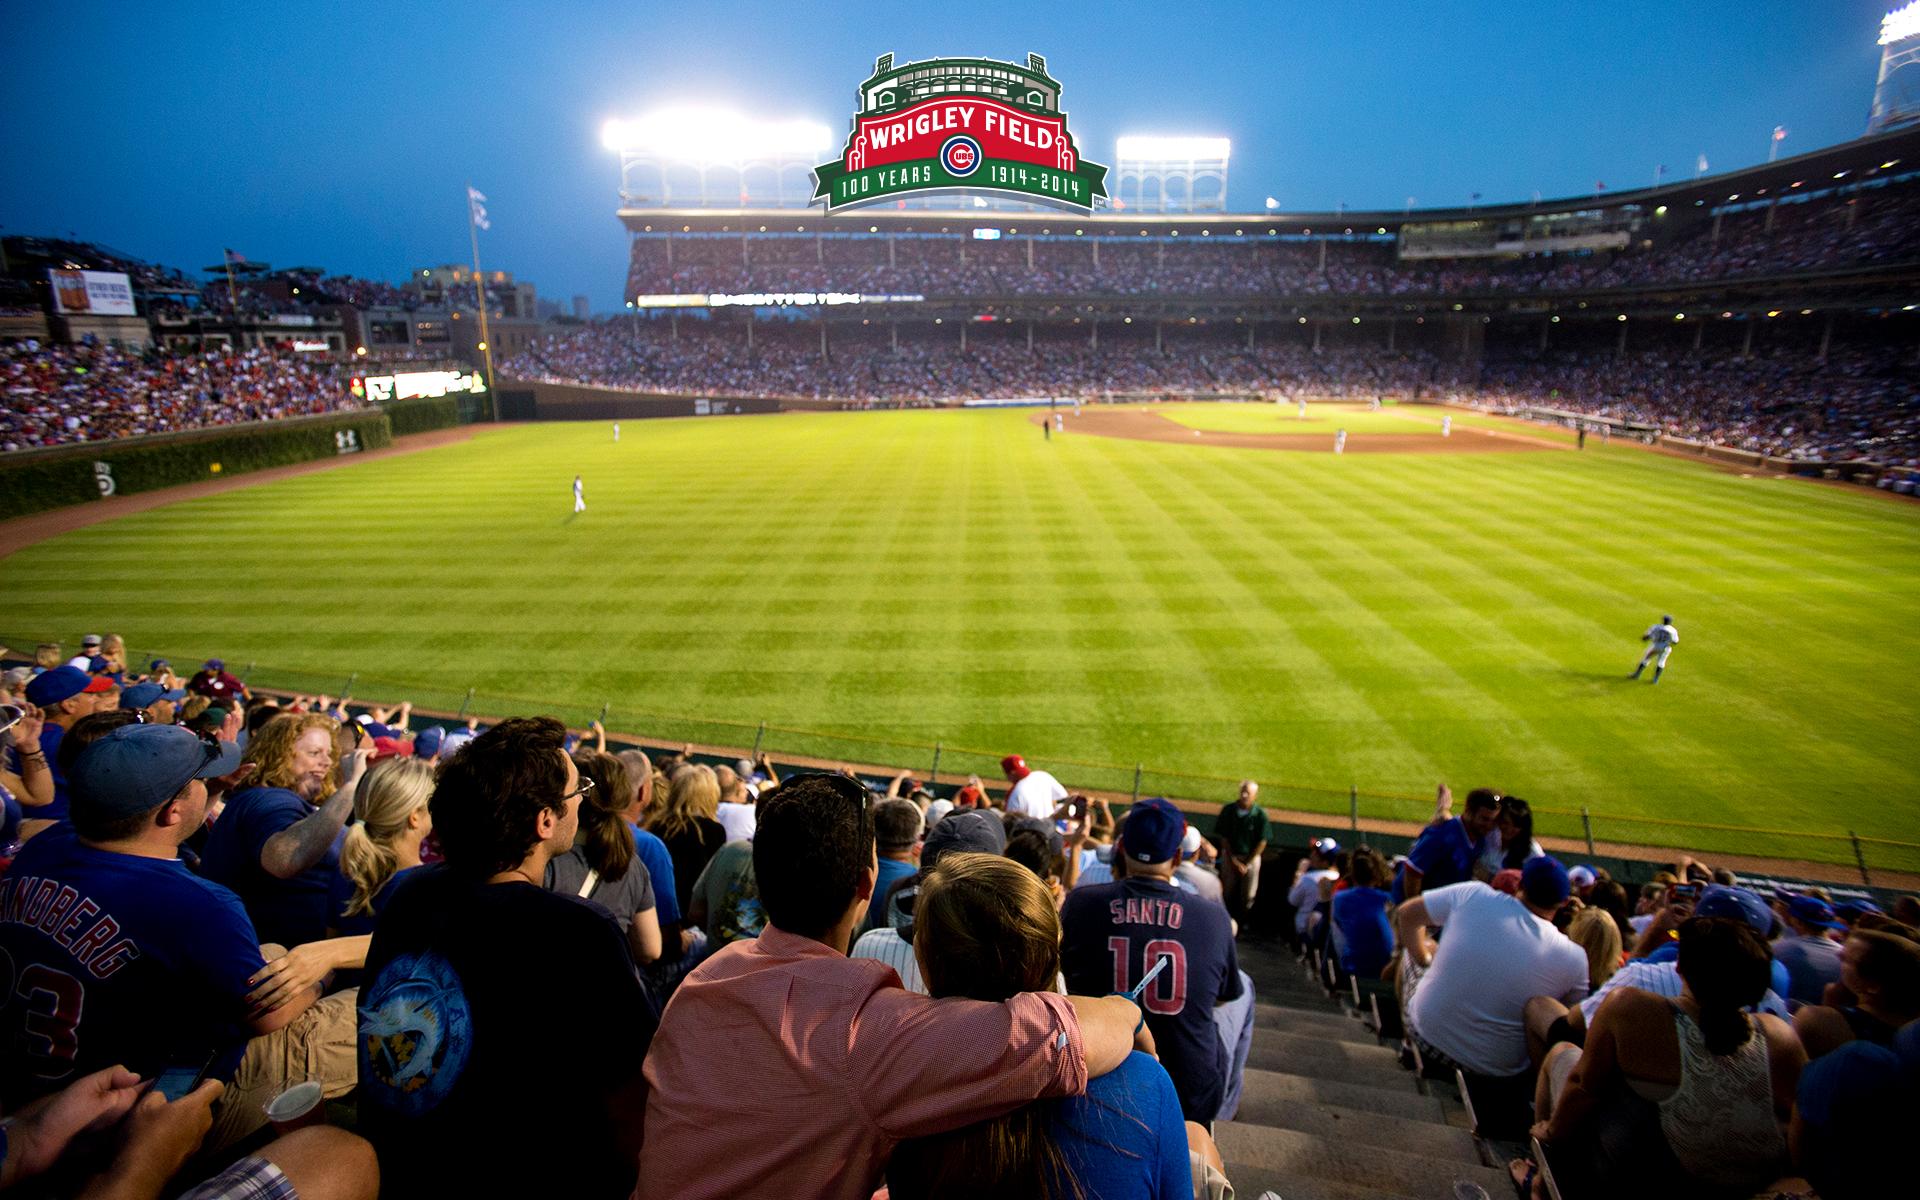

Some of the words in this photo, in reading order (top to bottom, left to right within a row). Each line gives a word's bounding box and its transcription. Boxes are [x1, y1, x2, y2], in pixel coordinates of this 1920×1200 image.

[1110, 897, 1184, 930] SANTO
[0, 945, 86, 1079] 3
[1108, 935, 1188, 1016] 10
